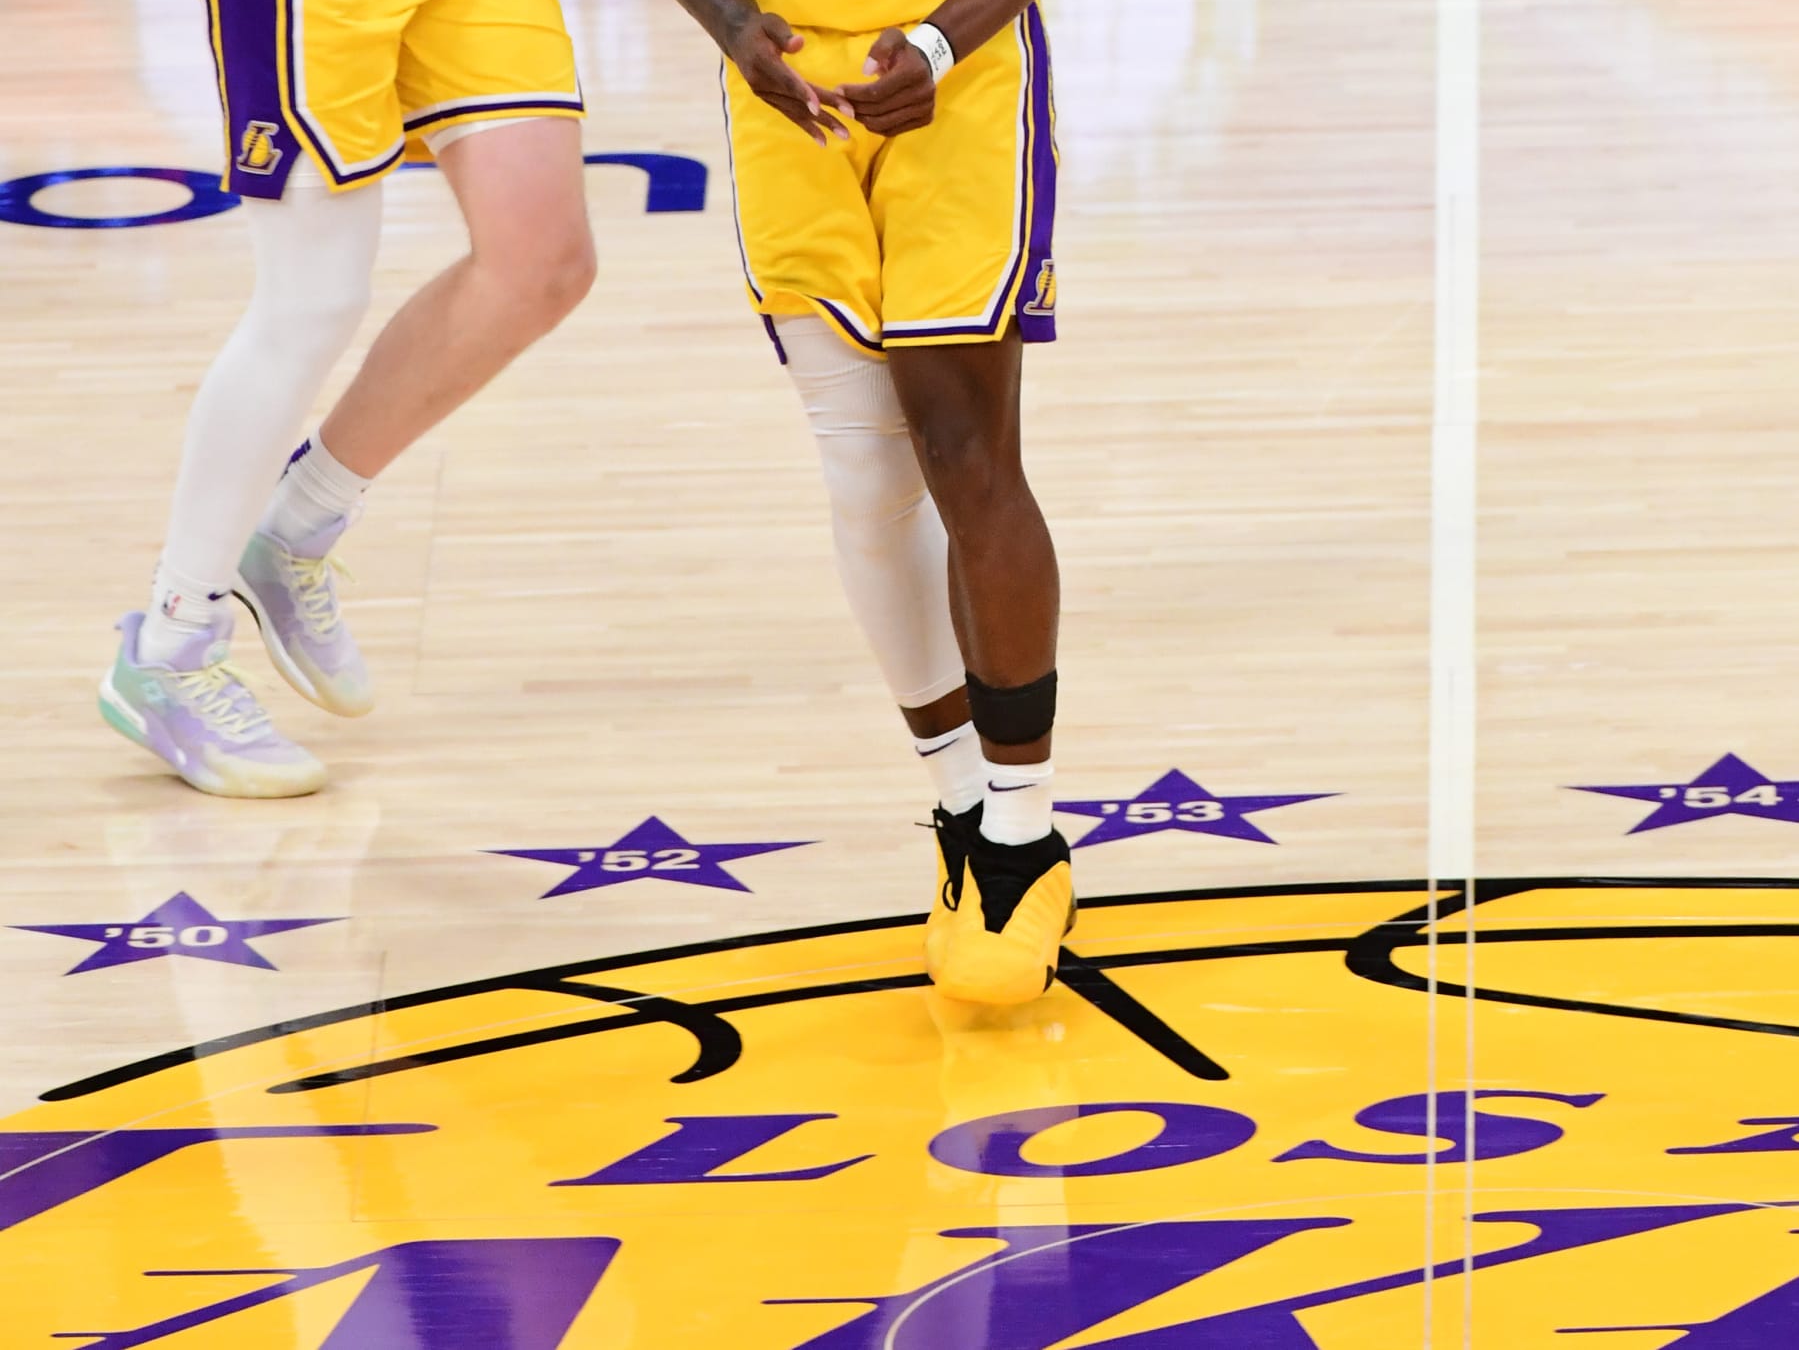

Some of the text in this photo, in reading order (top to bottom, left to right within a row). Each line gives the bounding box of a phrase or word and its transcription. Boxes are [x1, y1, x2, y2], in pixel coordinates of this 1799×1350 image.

[1658, 784, 1785, 809] '54
[1101, 800, 1226, 825] '53
[577, 848, 701, 872] '52
[104, 925, 229, 949] '50
[547, 1089, 1608, 1188] LOS
